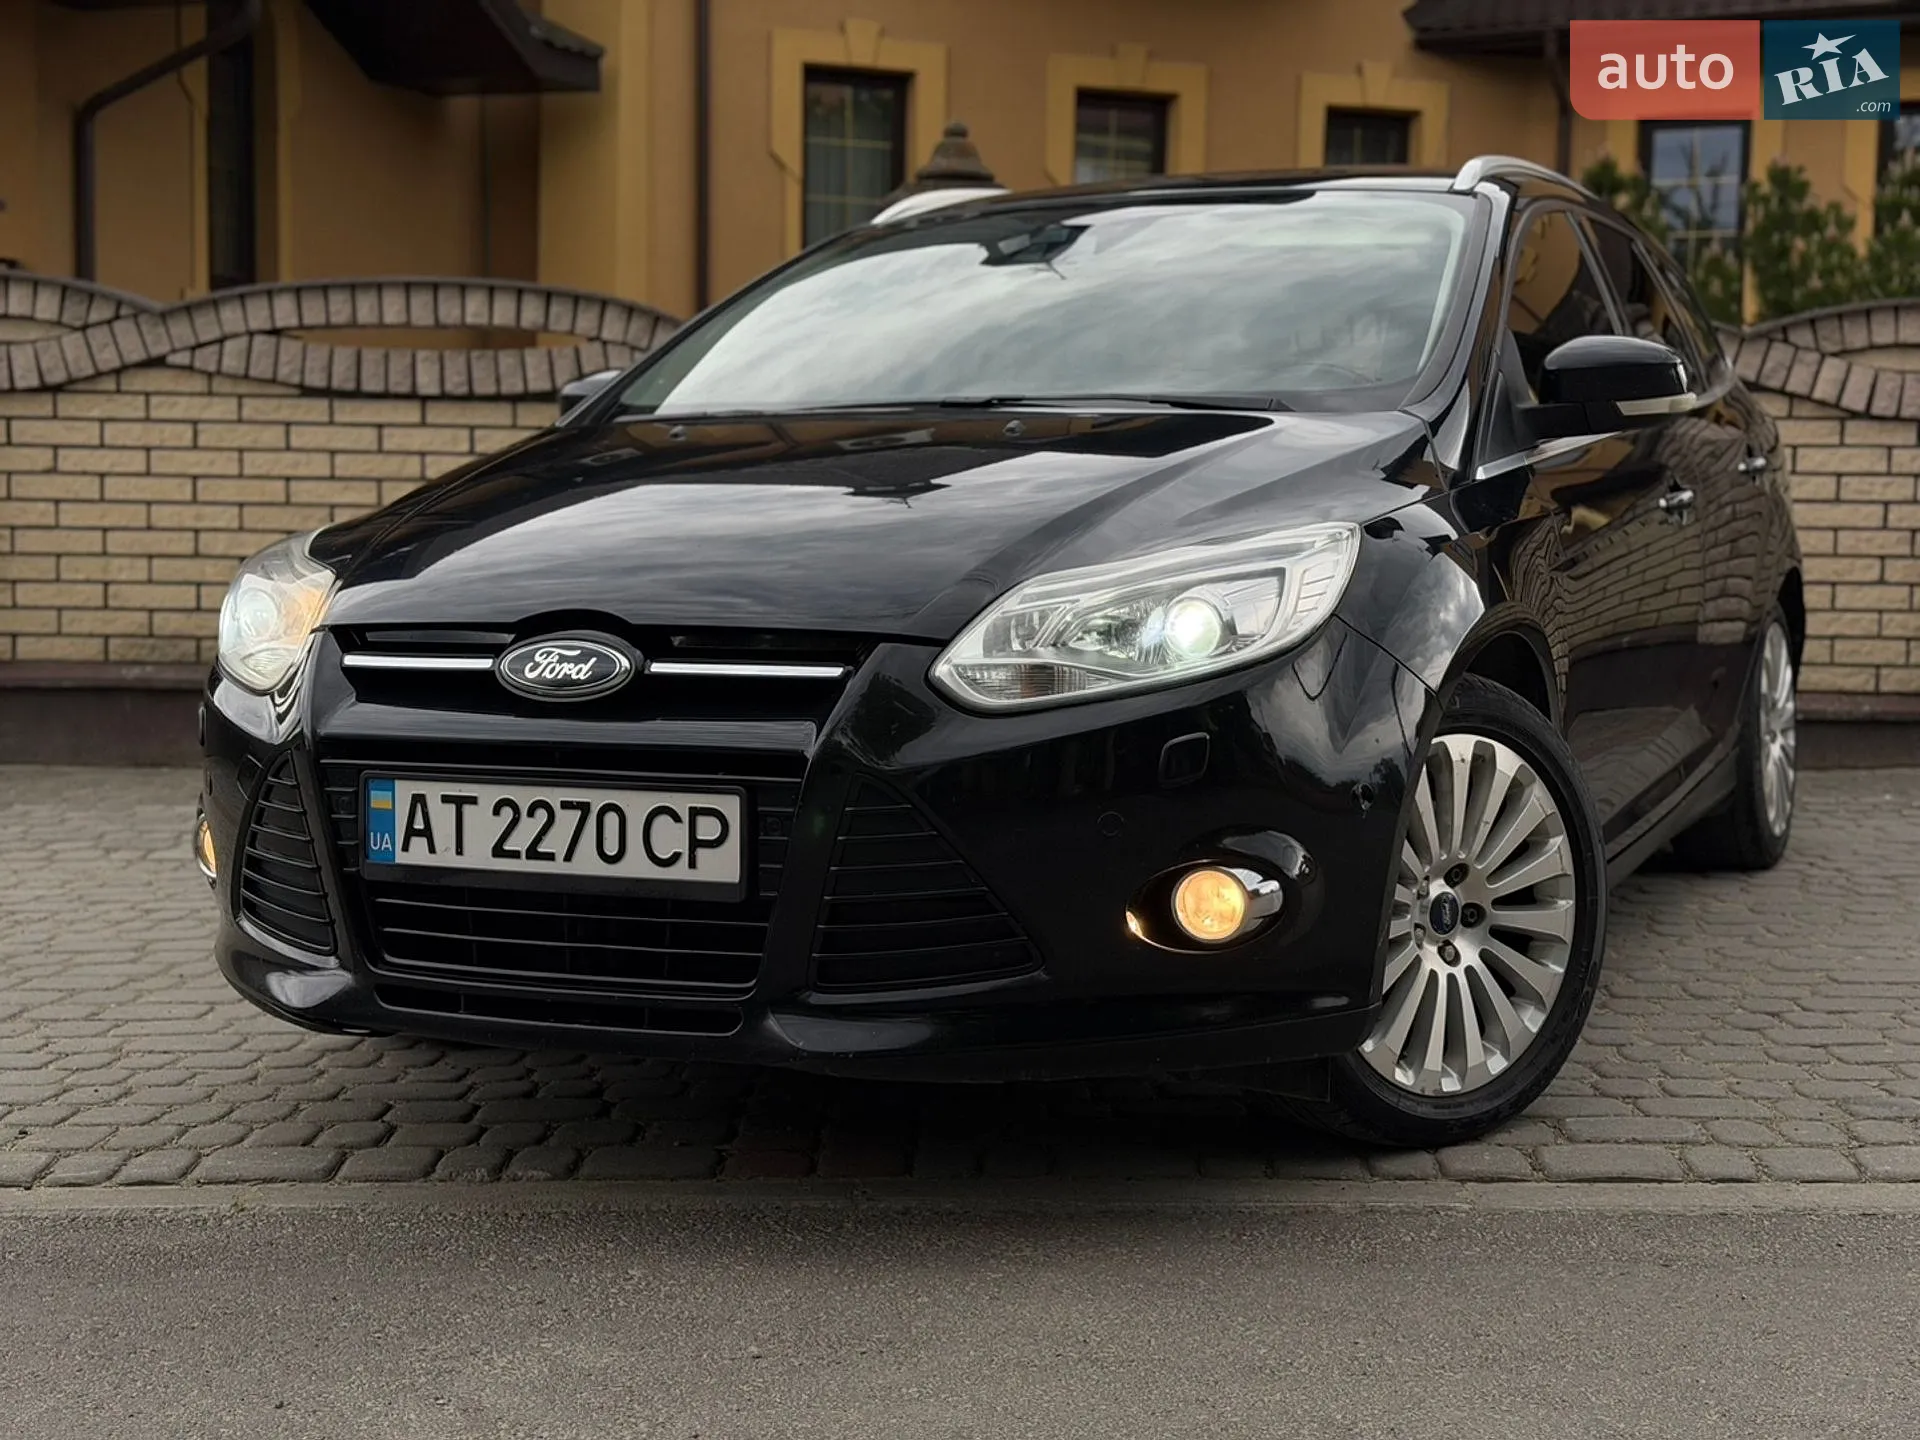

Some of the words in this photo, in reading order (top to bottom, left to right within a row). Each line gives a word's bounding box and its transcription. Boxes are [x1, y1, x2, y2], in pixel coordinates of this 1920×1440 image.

[524, 647, 597, 680] Ford
[370, 831, 393, 852] UA
[401, 792, 478, 856] AT
[491, 796, 627, 864] 2270
[642, 804, 730, 869] CP
